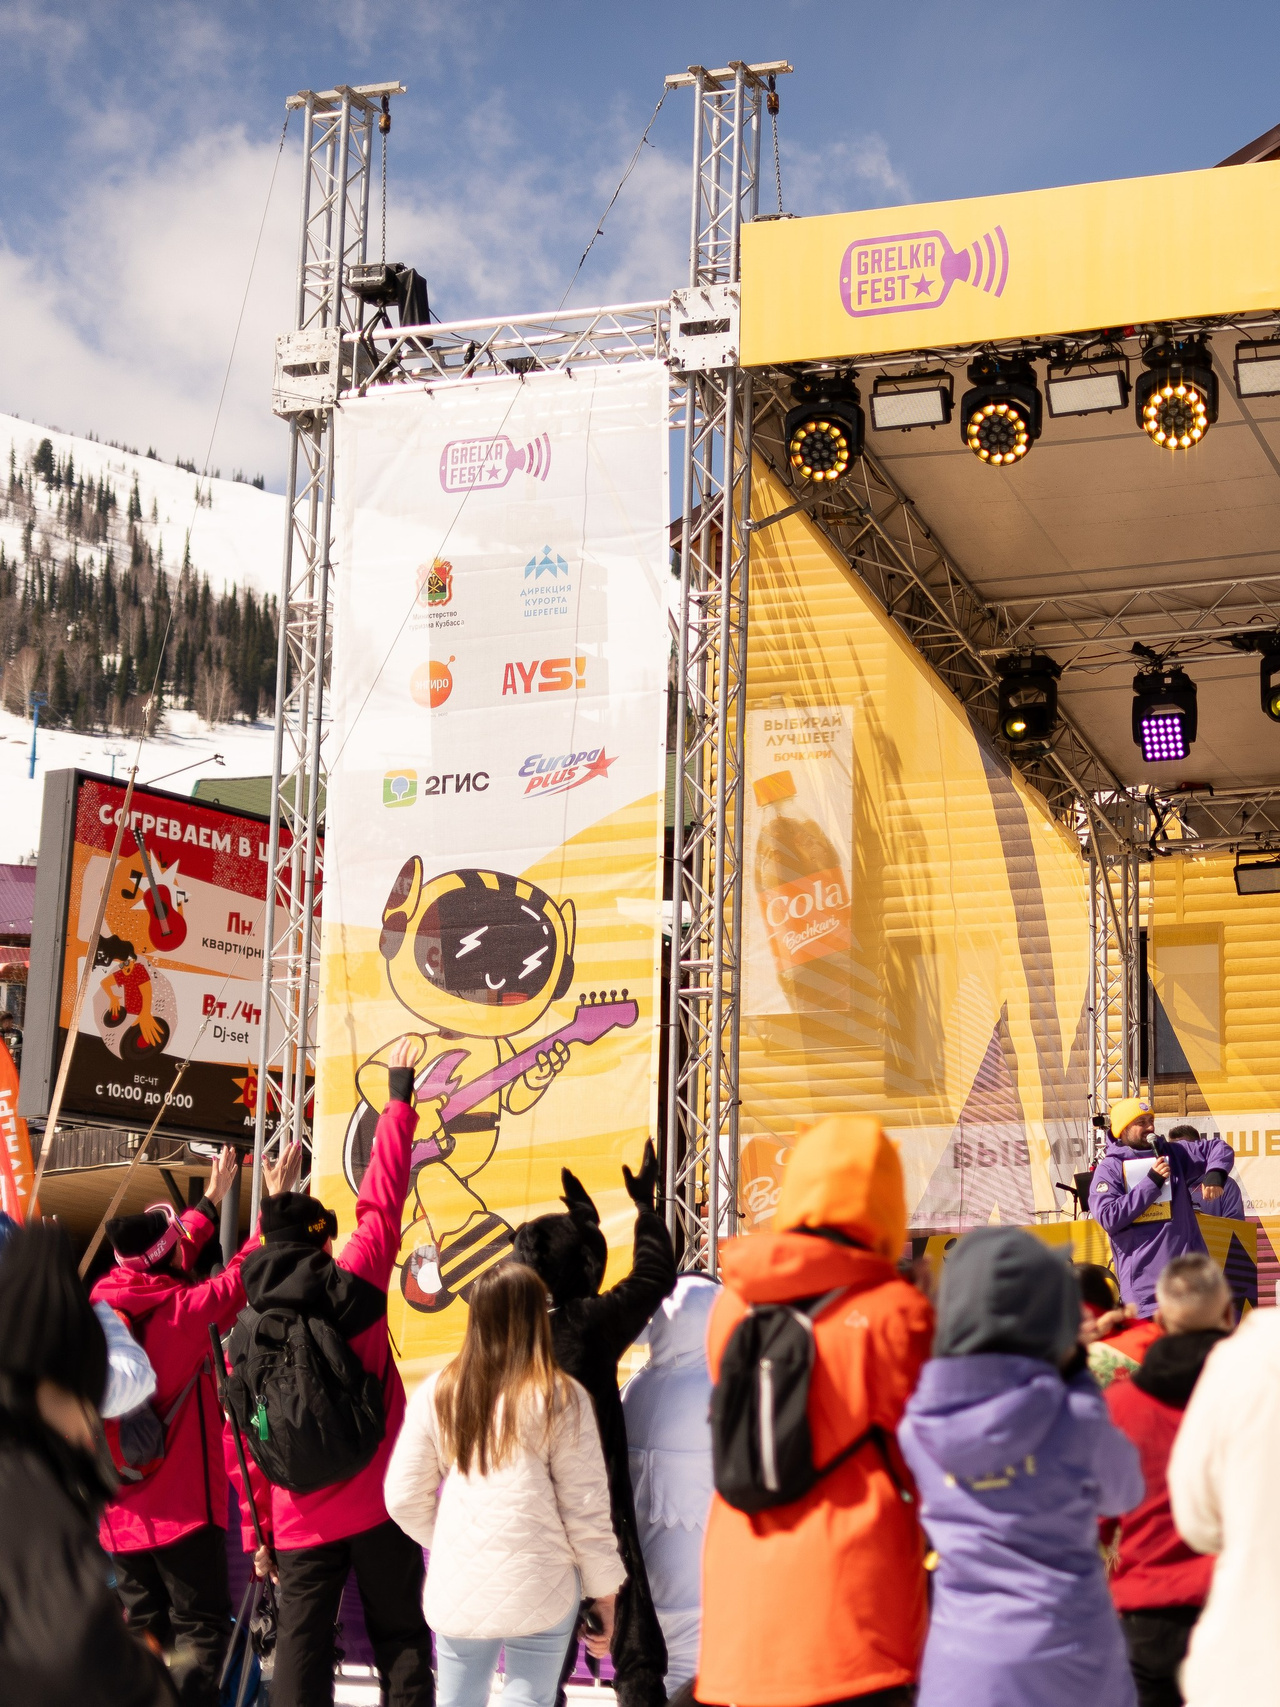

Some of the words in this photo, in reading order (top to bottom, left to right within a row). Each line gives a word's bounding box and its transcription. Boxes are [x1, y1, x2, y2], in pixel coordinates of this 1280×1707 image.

[857, 241, 936, 276] GRELKA
[857, 274, 910, 306] FEST
[450, 442, 504, 466] GRELKA
[450, 464, 486, 486] FEST
[519, 584, 572, 598] ДИРЕКЦИЯ
[525, 596, 568, 607] КУРОРТА
[523, 606, 569, 618] ШЕРЕГЕШ
[435, 619, 465, 630] Кузбасса
[501, 655, 587, 696] AYS!
[763, 712, 843, 732] ВЫБИРАЙ
[773, 749, 833, 763] БОЧКАРИ
[424, 771, 491, 797] 2ГИС
[98, 803, 232, 854] СОГРЕВАЕМ
[238, 836, 251, 858] В
[765, 880, 845, 929] Cola
[227, 911, 256, 938] Пн.
[782, 915, 840, 949] Bochkari
[212, 1025, 250, 1045] Dj-set
[106, 1082, 142, 1102] 10:00
[144, 1091, 161, 1105] до
[163, 1091, 194, 1110] 0:00
[243, 1115, 274, 1130] APES
